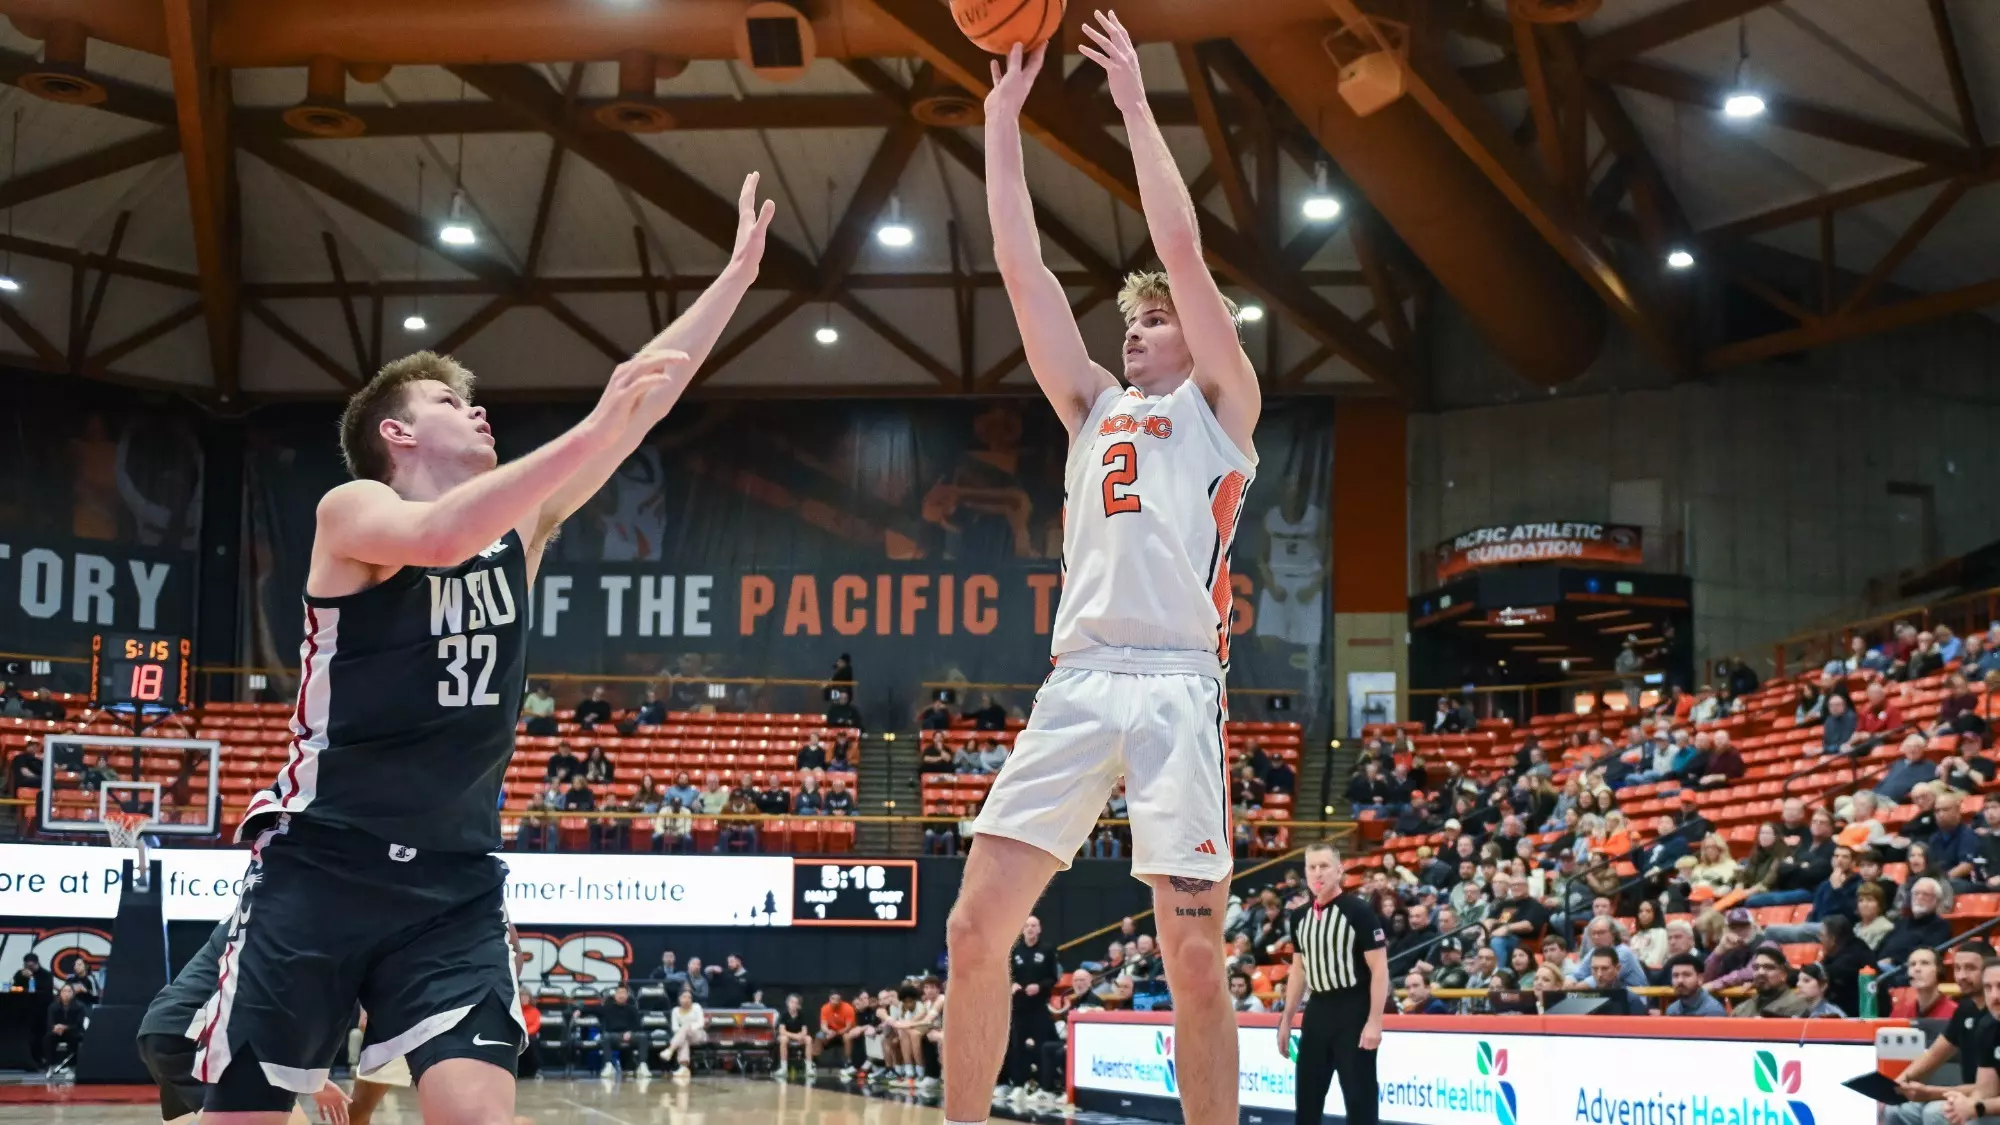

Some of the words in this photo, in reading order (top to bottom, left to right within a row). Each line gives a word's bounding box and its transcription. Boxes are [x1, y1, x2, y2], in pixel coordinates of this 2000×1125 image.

[1101, 441, 1142, 518] 2
[1510, 522, 1603, 540] ATHLETIC
[0, 543, 171, 630] ORY
[426, 566, 516, 636] WSU
[529, 576, 573, 636] F
[600, 576, 713, 636] THE
[739, 574, 999, 636] PACIFIC
[125, 640, 169, 661] 5:15
[131, 664, 163, 700] 18
[437, 634, 500, 707] 32
[60, 871, 89, 893] at
[815, 904, 826, 919] 1
[1378, 1076, 1433, 1109] ventist
[1436, 1077, 1495, 1113] Health
[1576, 1087, 1687, 1125] Adventist
[1692, 1095, 1780, 1125] Health
